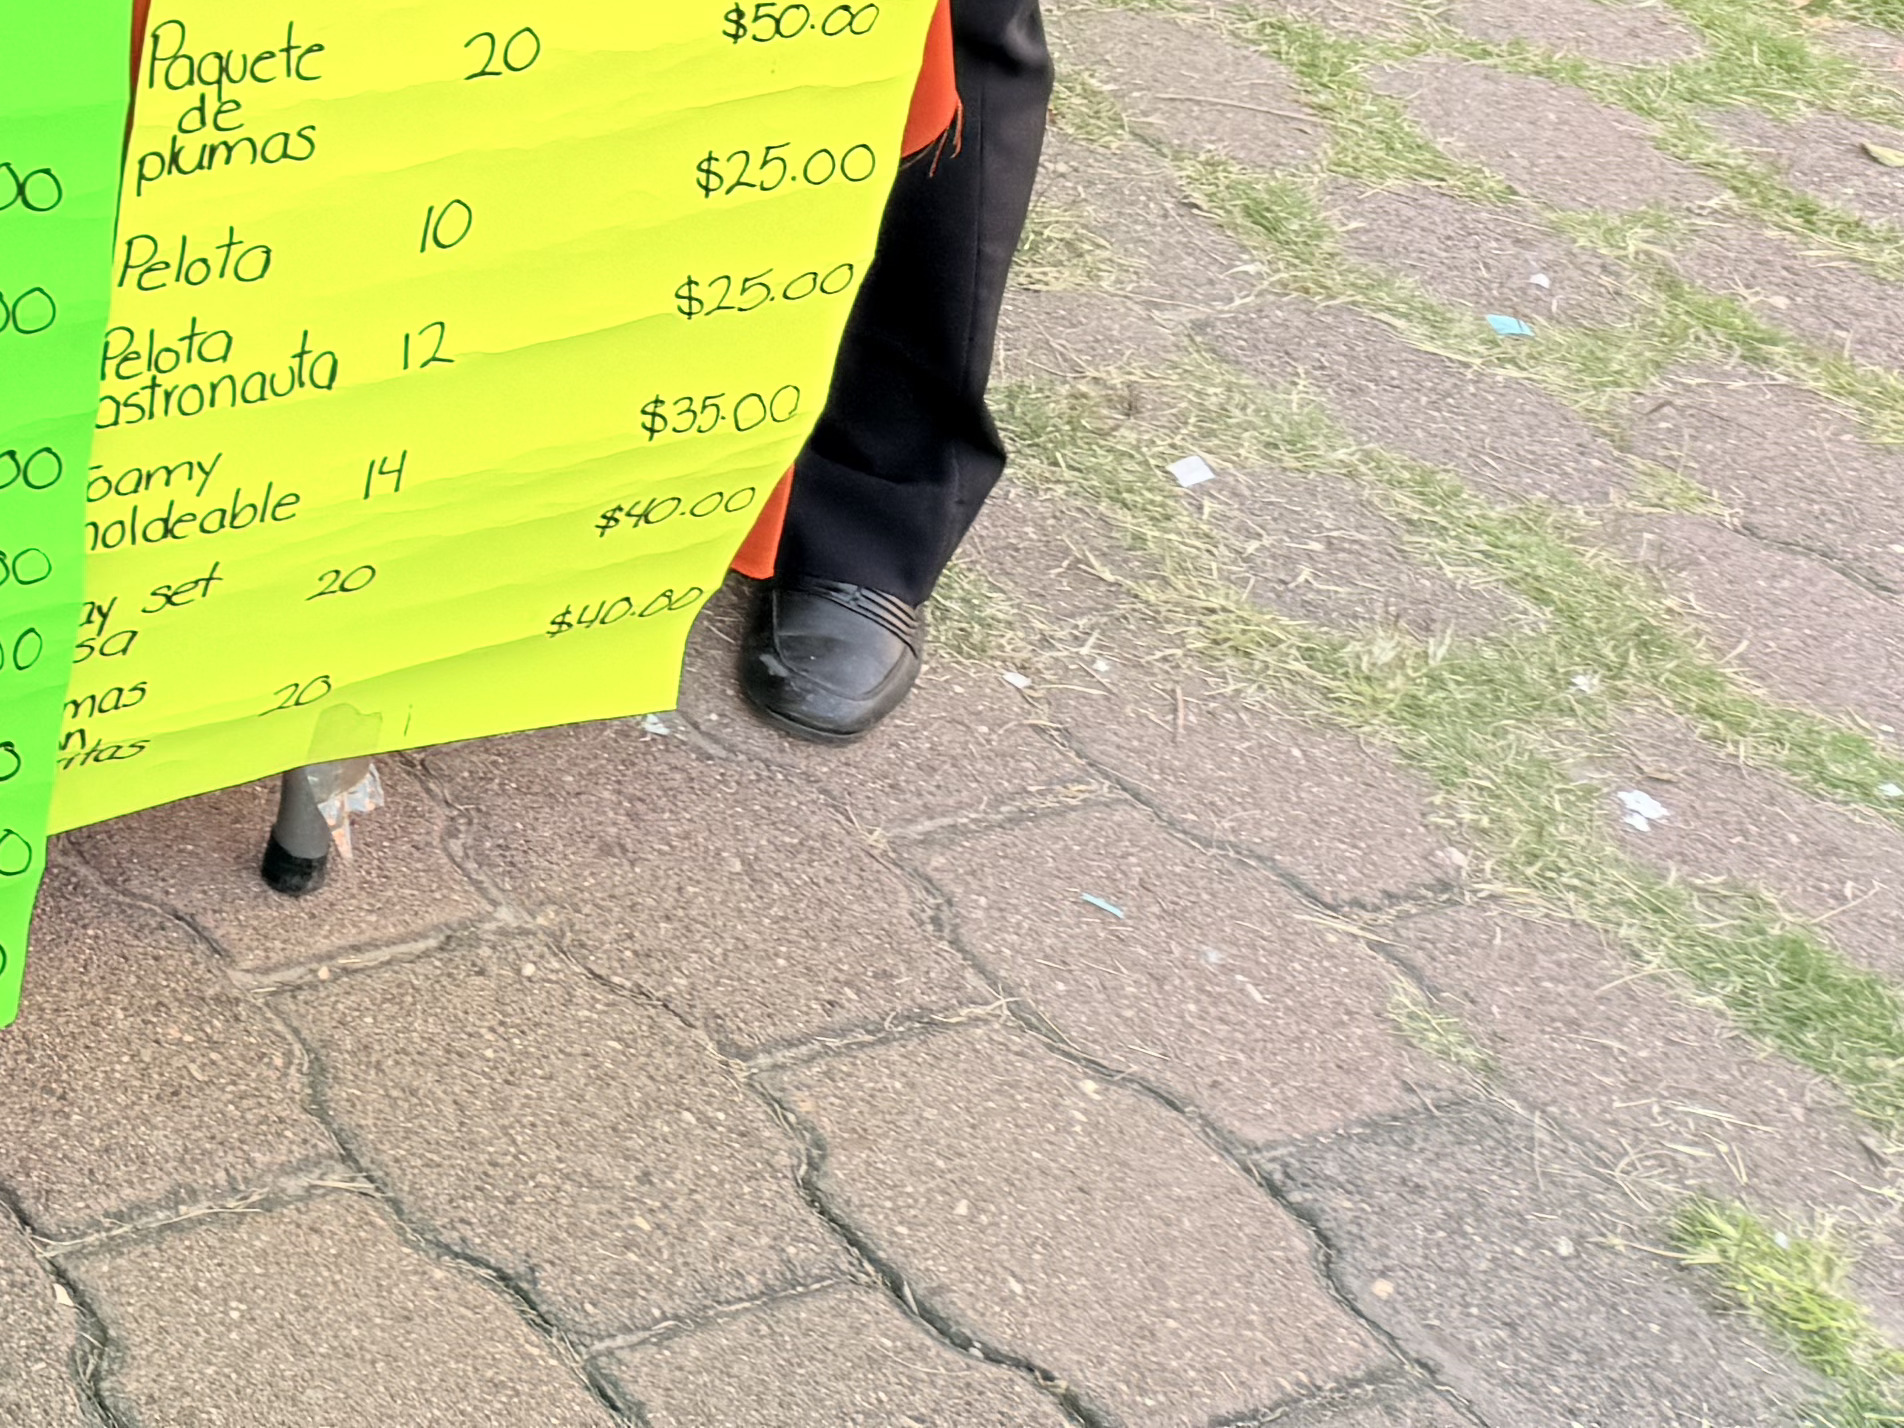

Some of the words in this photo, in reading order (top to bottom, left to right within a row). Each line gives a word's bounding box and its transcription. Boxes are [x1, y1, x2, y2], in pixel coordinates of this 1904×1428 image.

[149, 20, 324, 94] Paquete
[176, 93, 244, 134] de
[137, 125, 315, 197] plumas
[697, 142, 875, 198] $25.00
[118, 226, 272, 291] Pelota
[95, 326, 338, 429] astronauta
[101, 317, 233, 380] Pelota
[640, 385, 800, 441] $35.00
